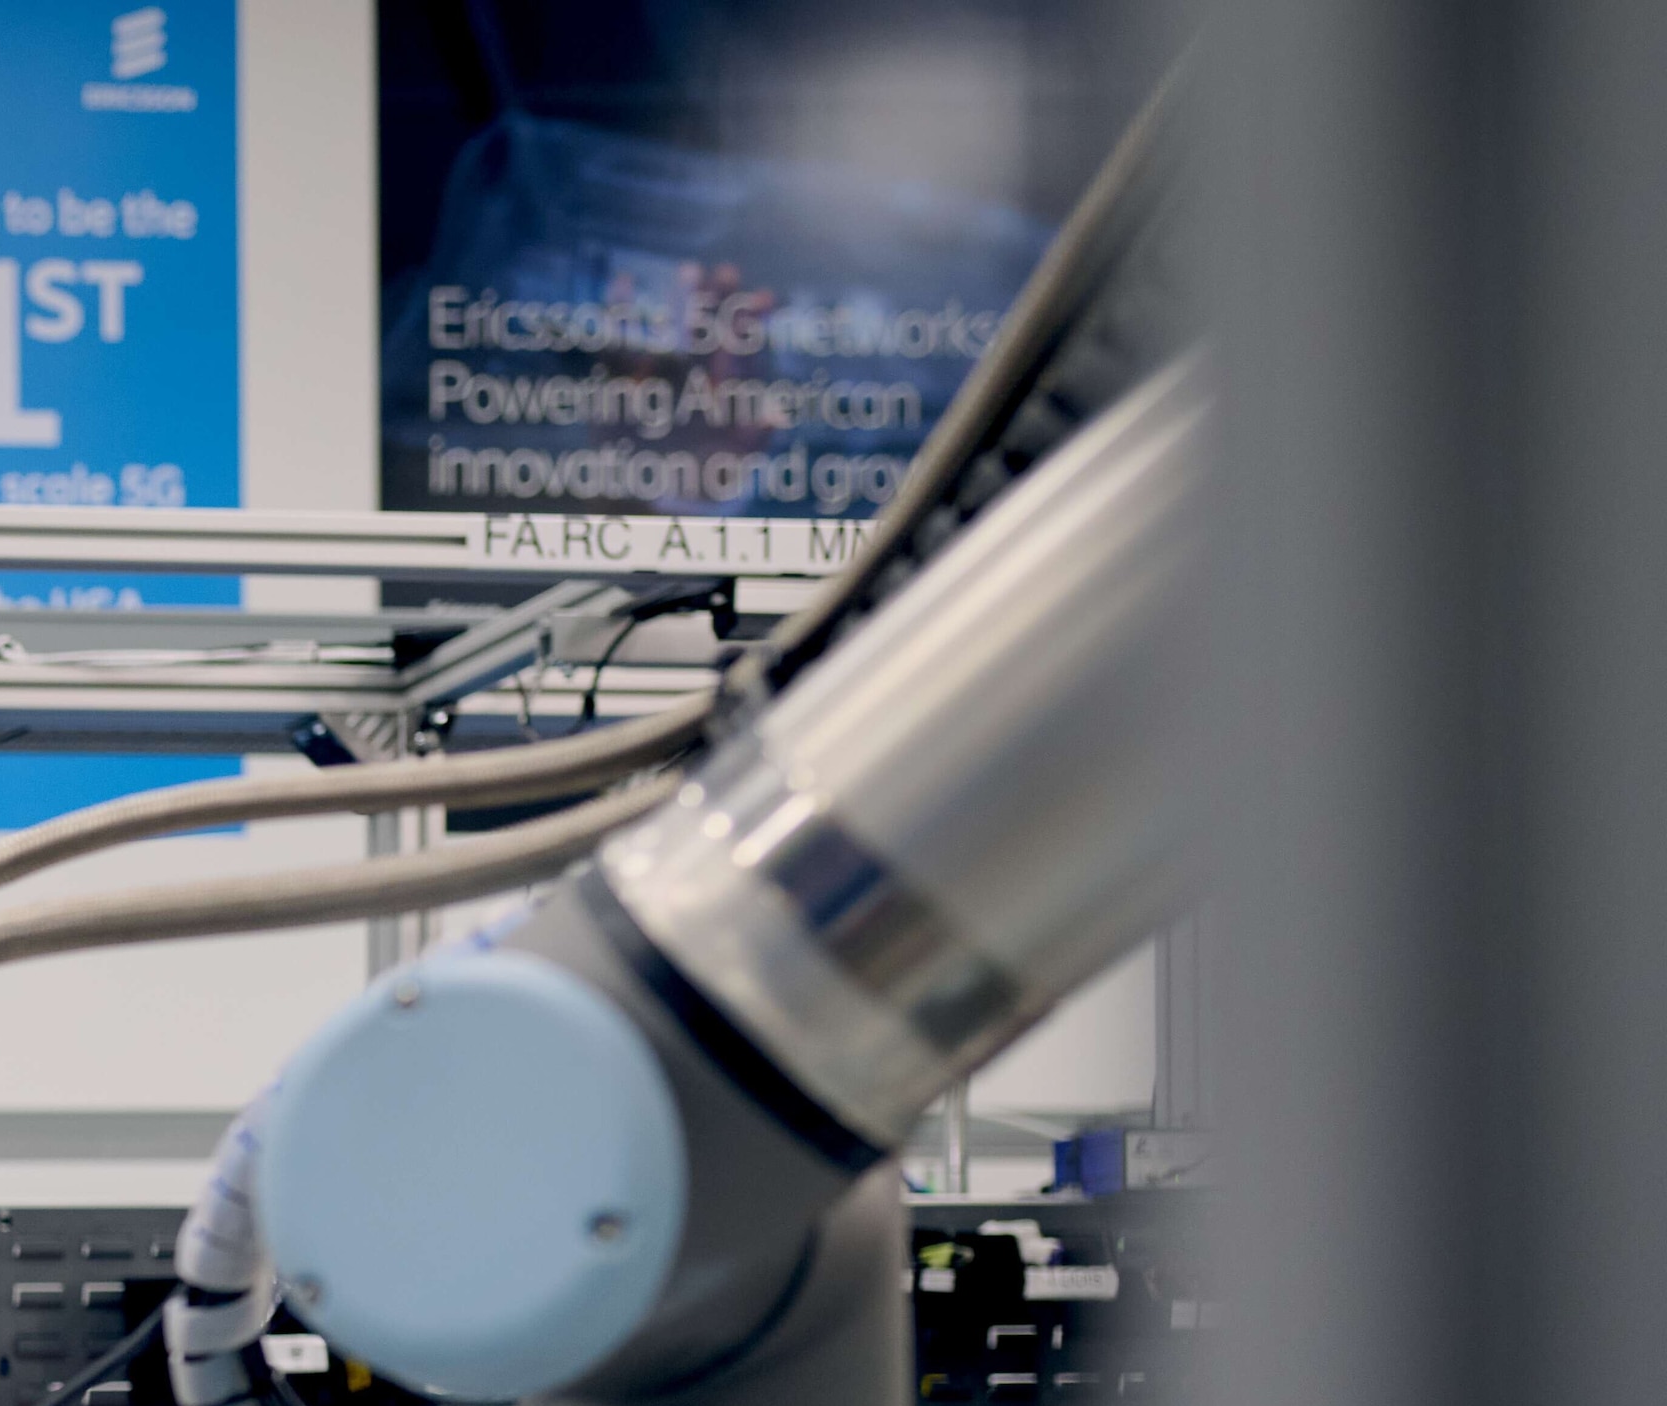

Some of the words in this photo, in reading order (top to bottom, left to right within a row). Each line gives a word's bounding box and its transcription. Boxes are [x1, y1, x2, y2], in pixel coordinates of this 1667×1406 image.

[3, 189, 54, 237] to
[57, 186, 116, 238] be
[121, 188, 199, 240] the
[690, 293, 770, 356] 5G
[428, 359, 675, 440] Powering
[680, 366, 922, 430] American
[428, 433, 701, 500] innovation
[702, 440, 808, 501] and
